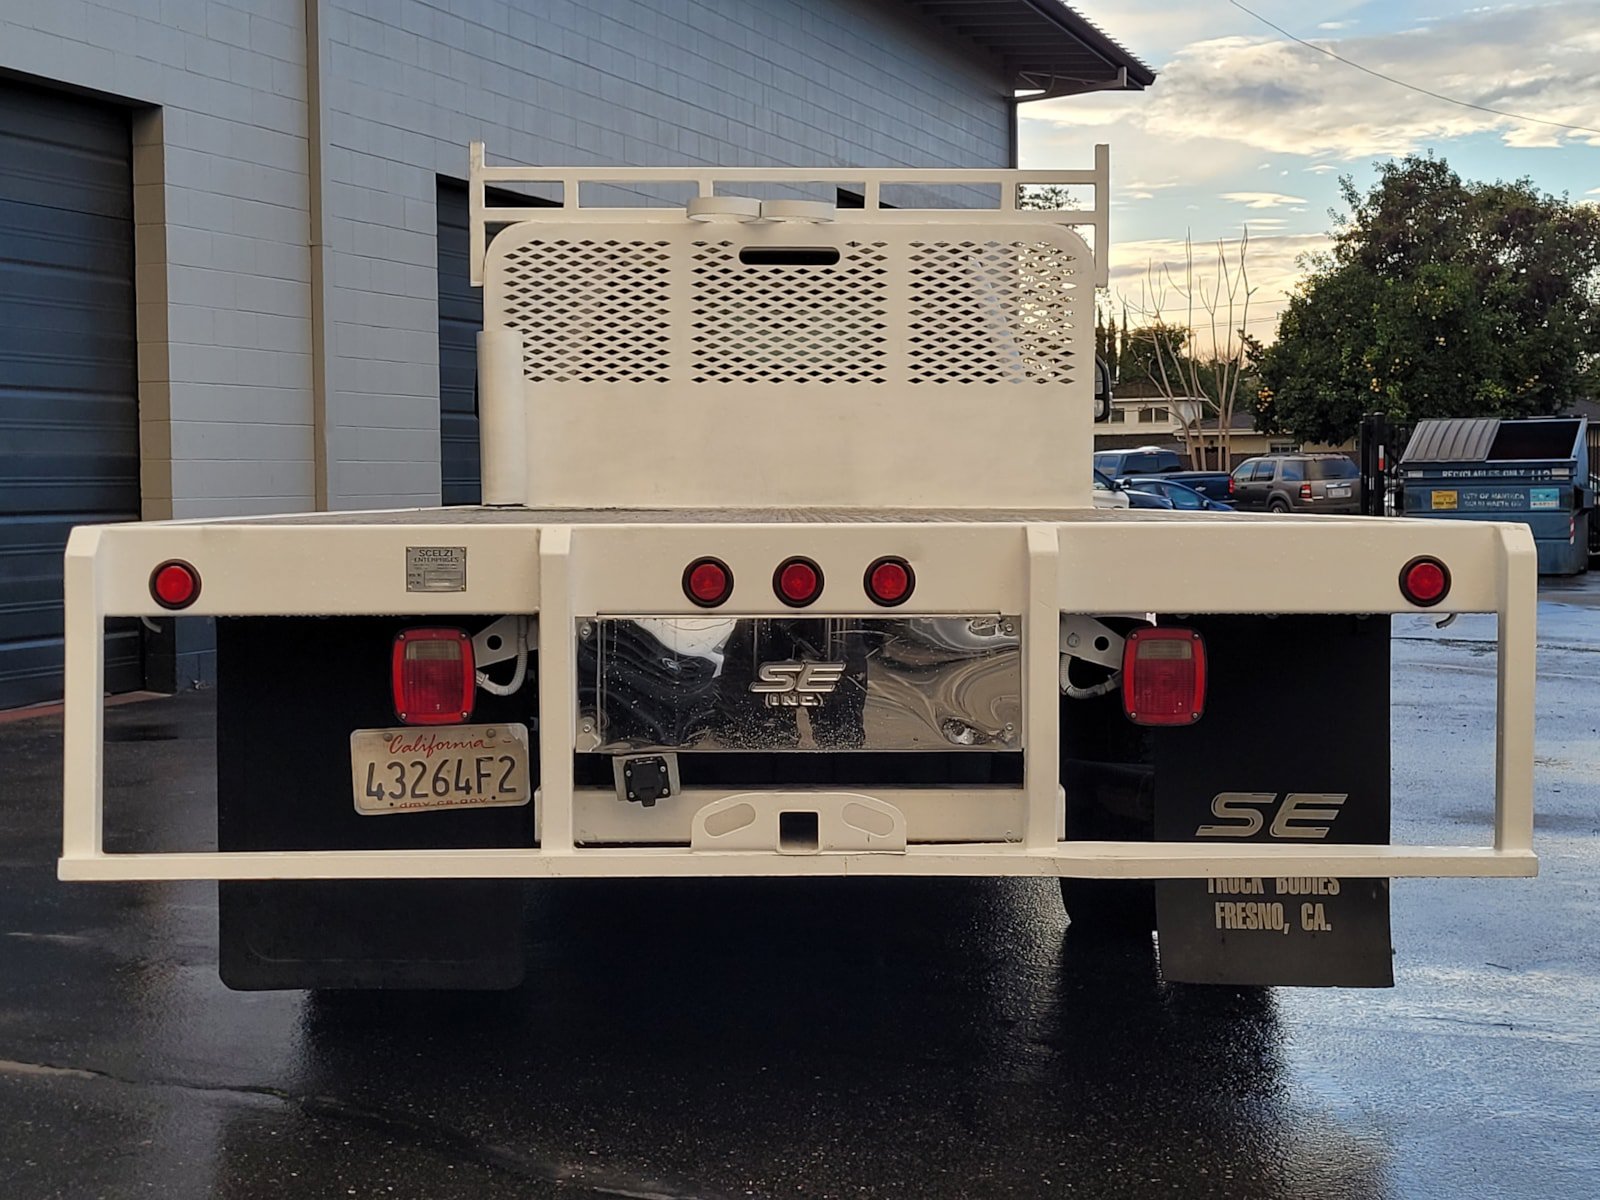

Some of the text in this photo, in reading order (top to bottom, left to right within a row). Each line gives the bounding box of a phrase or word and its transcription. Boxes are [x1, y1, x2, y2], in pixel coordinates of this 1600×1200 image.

[748, 661, 847, 693] SE
[389, 734, 495, 758] California
[366, 755, 517, 801] 43264F2
[1195, 792, 1348, 838] SE
[1207, 877, 1340, 895] TRUCK BODIES
[1215, 902, 1332, 935] FRESNO, CA.
